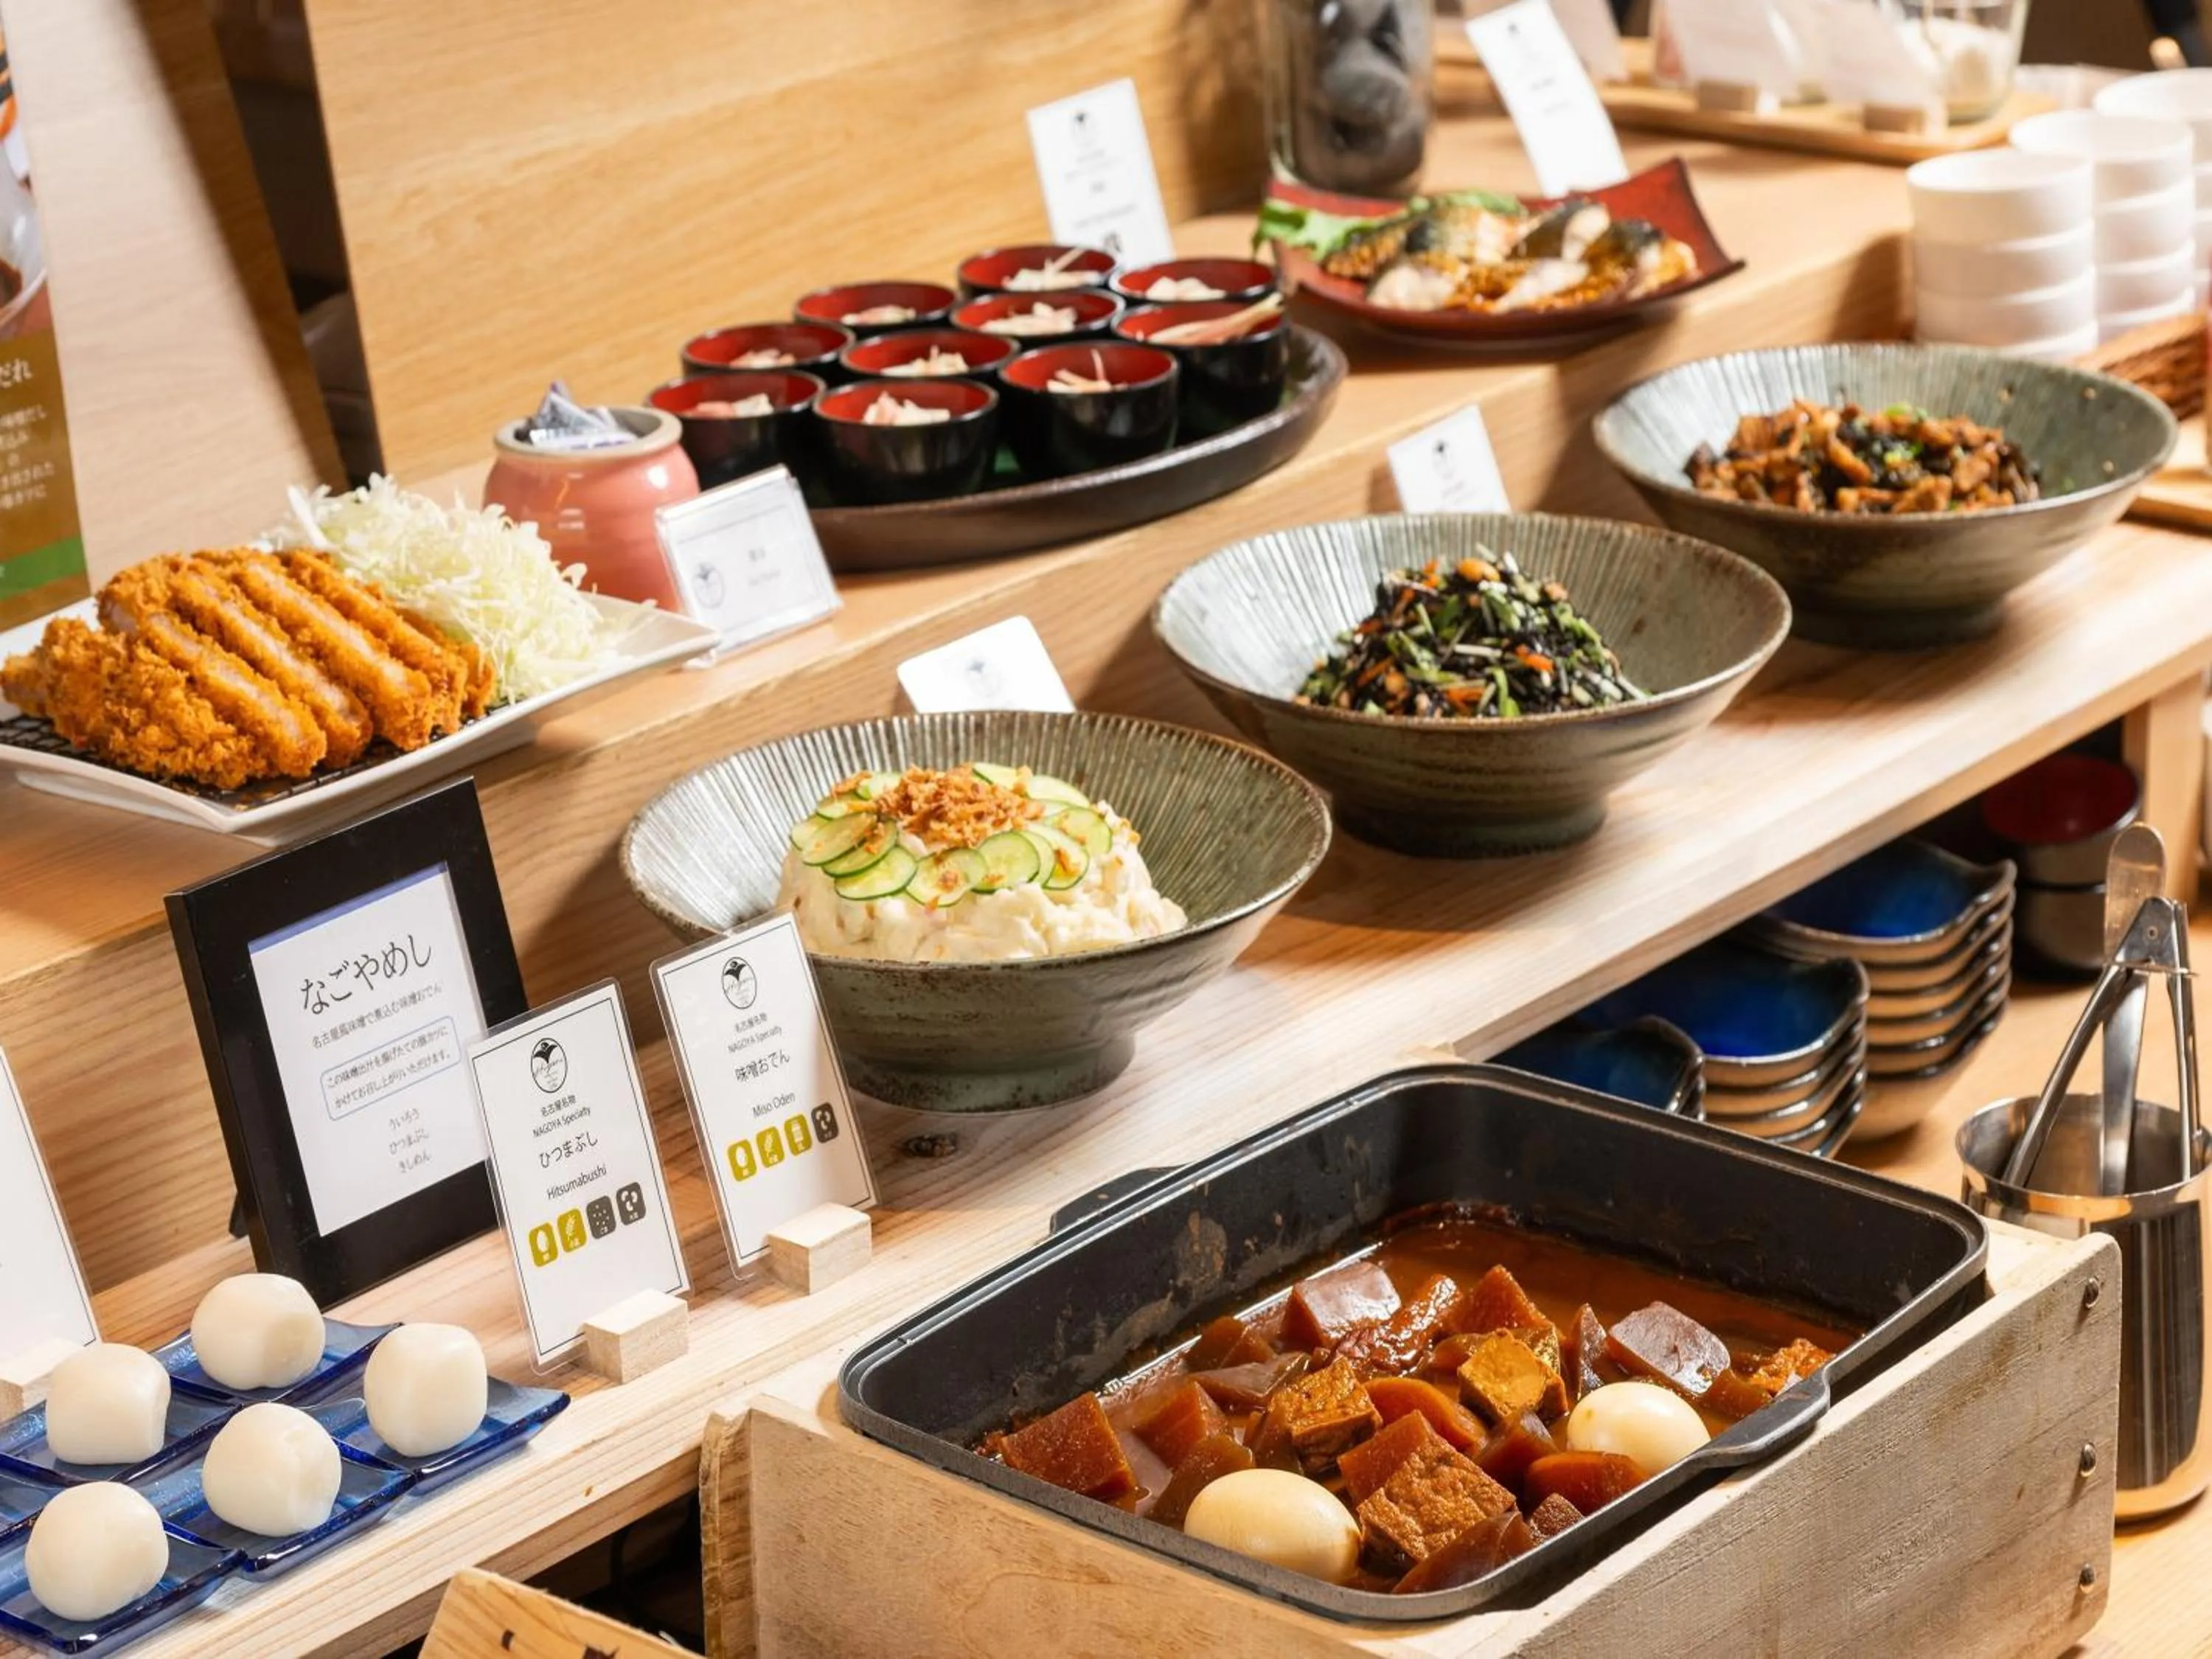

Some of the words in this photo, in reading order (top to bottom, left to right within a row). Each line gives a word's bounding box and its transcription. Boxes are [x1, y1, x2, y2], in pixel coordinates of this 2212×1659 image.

[301, 935, 431, 1015] なごやめし
[734, 1050, 790, 1082] 味噌おでん
[752, 1102, 773, 1118] Miso
[773, 1092, 796, 1109] Oden
[533, 1119, 562, 1137] NAGOYA
[561, 1107, 591, 1125] Specialty
[389, 1128, 429, 1155] ひつまぶし
[539, 1132, 598, 1169] ひつまぶし
[546, 1163, 607, 1200] Hitsumabushi
